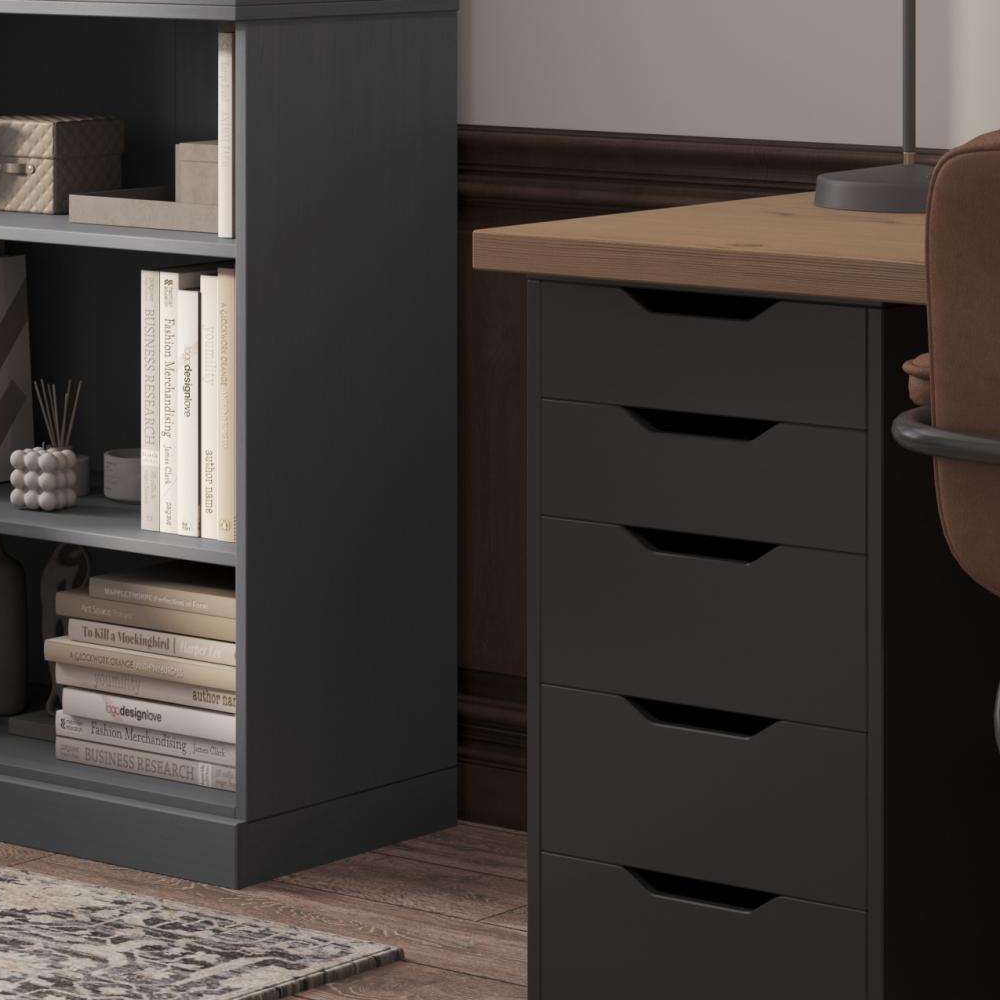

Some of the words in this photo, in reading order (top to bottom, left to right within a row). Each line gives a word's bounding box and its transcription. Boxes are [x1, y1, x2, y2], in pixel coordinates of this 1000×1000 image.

[144, 309, 155, 371] BUSINESS
[164, 318, 176, 357] Fashion
[144, 374, 155, 445] RESEARCH
[162, 361, 175, 439] Merchandising
[205, 449, 215, 484] author
[205, 486, 215, 514] name
[82, 626, 93, 637] To
[95, 627, 109, 640] Kill
[118, 631, 170, 650] Mockingbird
[106, 704, 162, 723] logodesignlove
[192, 689, 221, 704] author
[91, 722, 122, 738] Fashion
[125, 728, 187, 754] Merchandising
[192, 744, 209, 754] James
[209, 746, 226, 757] Clark
[85, 747, 135, 769] BUSINESS
[137, 758, 194, 781] RESEARCH
